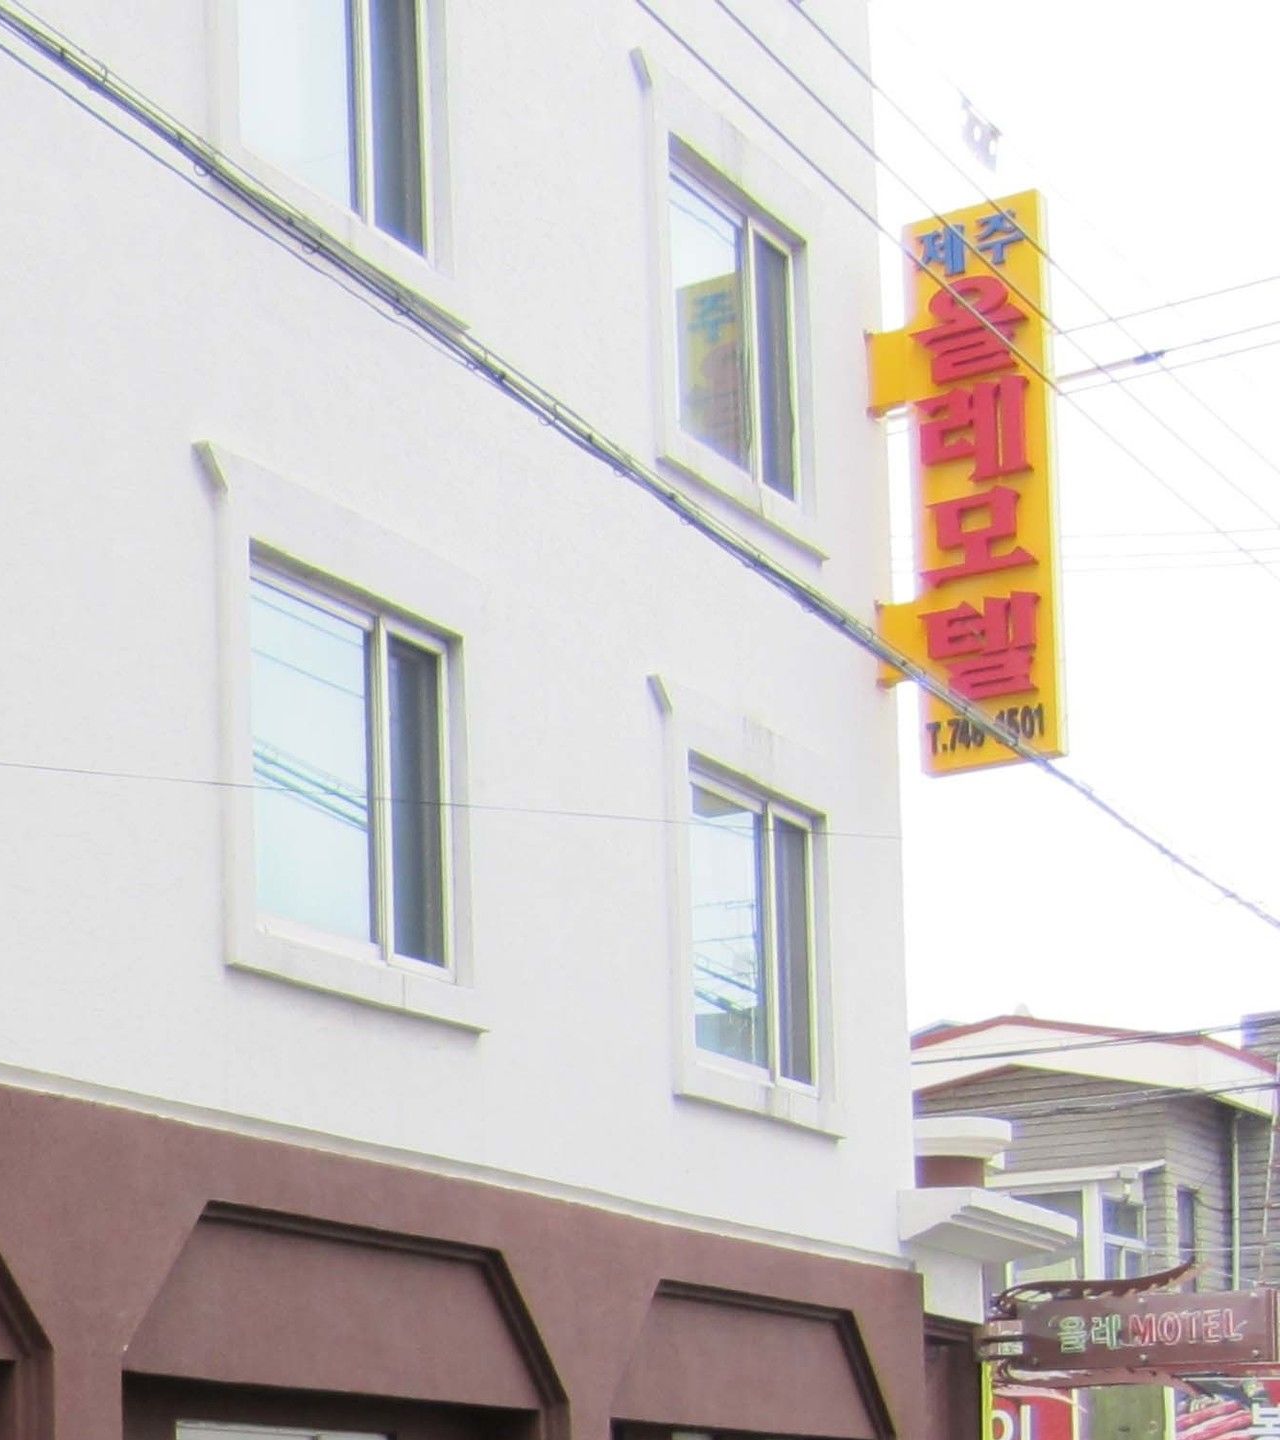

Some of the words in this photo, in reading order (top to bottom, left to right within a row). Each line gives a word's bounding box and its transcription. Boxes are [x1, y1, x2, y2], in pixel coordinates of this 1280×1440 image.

[914, 208, 1025, 277] 제주
[909, 275, 1042, 701] 올레모텔
[1058, 1314, 1123, 1353] 올레
[1128, 1308, 1246, 1346] MOTEL
